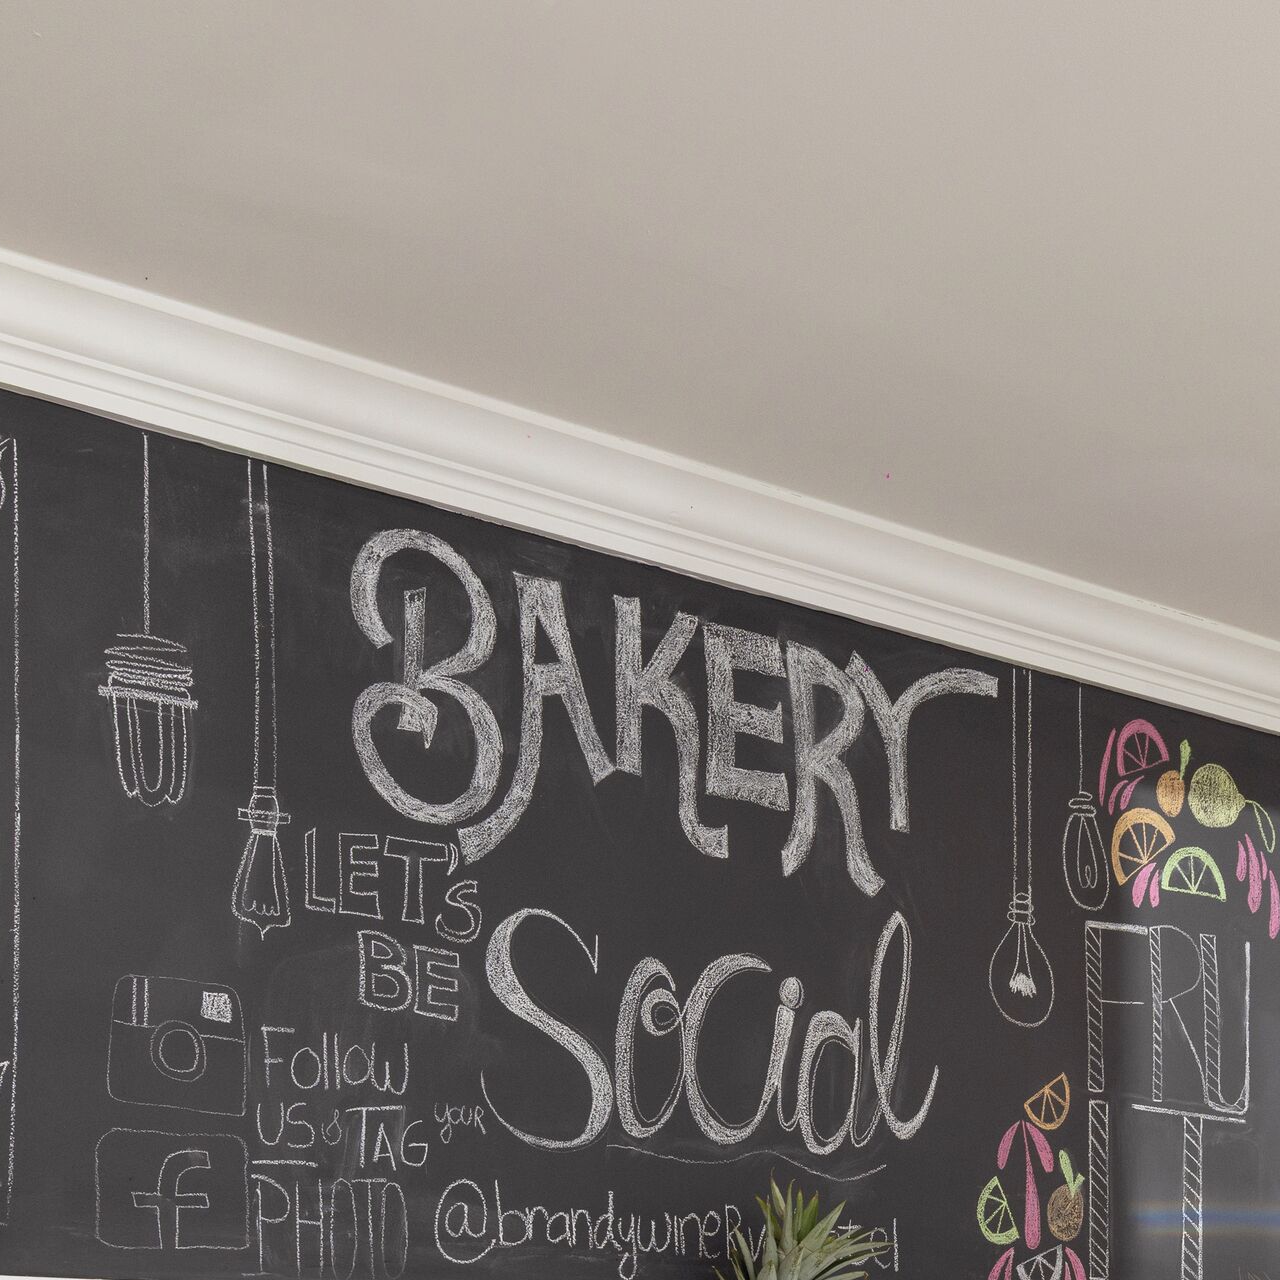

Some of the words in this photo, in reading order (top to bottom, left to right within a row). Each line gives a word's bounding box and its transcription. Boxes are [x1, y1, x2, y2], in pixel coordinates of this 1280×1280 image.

[349, 528, 999, 897] BAKERY
[304, 828, 483, 943] LET'S
[357, 930, 460, 1022] BE
[260, 1024, 409, 1095] Follow
[345, 1105, 428, 1171] TAG
[241, 1174, 409, 1280] PHOTO
